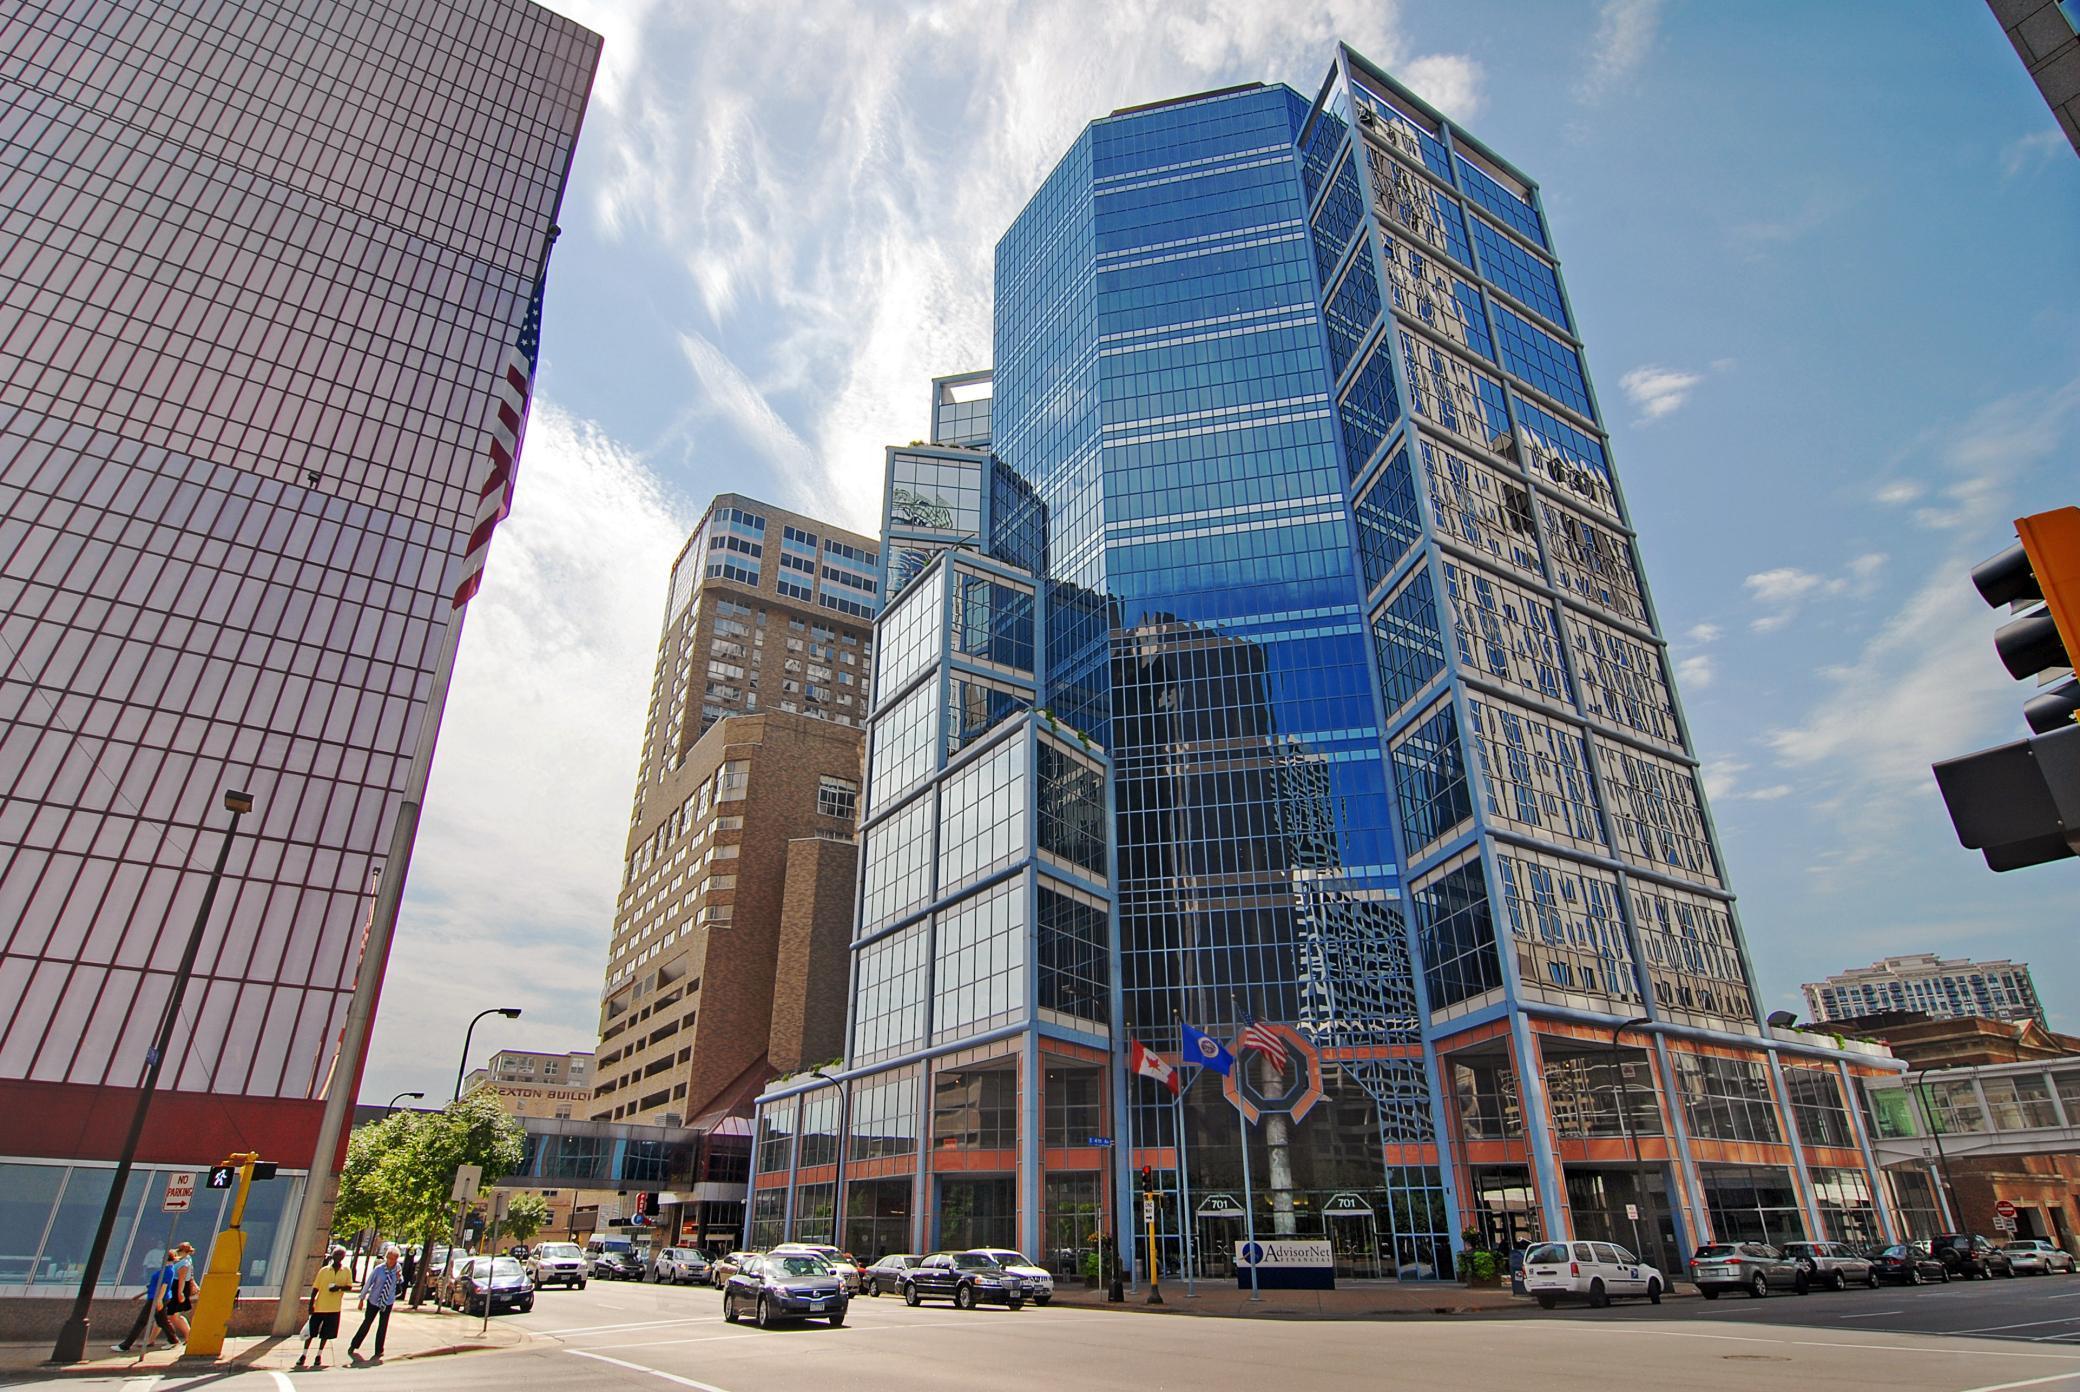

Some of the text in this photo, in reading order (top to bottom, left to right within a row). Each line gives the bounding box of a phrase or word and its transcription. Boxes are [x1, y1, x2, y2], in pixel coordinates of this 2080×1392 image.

[487, 1085, 541, 1098] EXTON
[177, 1175, 188, 1184] NO
[167, 1187, 193, 1197] PARKING
[1211, 1200, 1228, 1209] 701
[1338, 1199, 1356, 1208] 701
[1264, 1244, 1330, 1262] AdvisorNet
